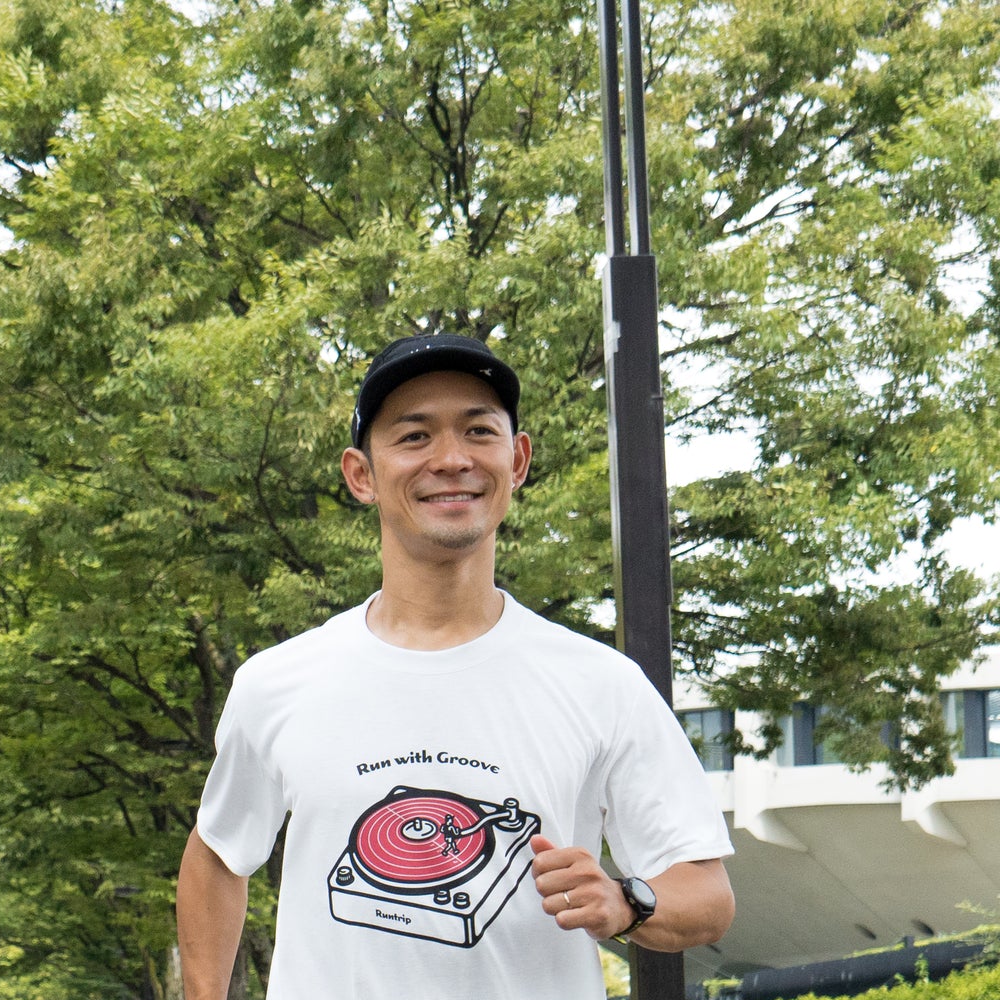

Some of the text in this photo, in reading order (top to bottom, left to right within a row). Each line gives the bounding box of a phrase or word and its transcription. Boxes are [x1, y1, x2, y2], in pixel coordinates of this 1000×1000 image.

[356, 749, 501, 776] Run with Groove
[375, 908, 412, 926] Runtrip
